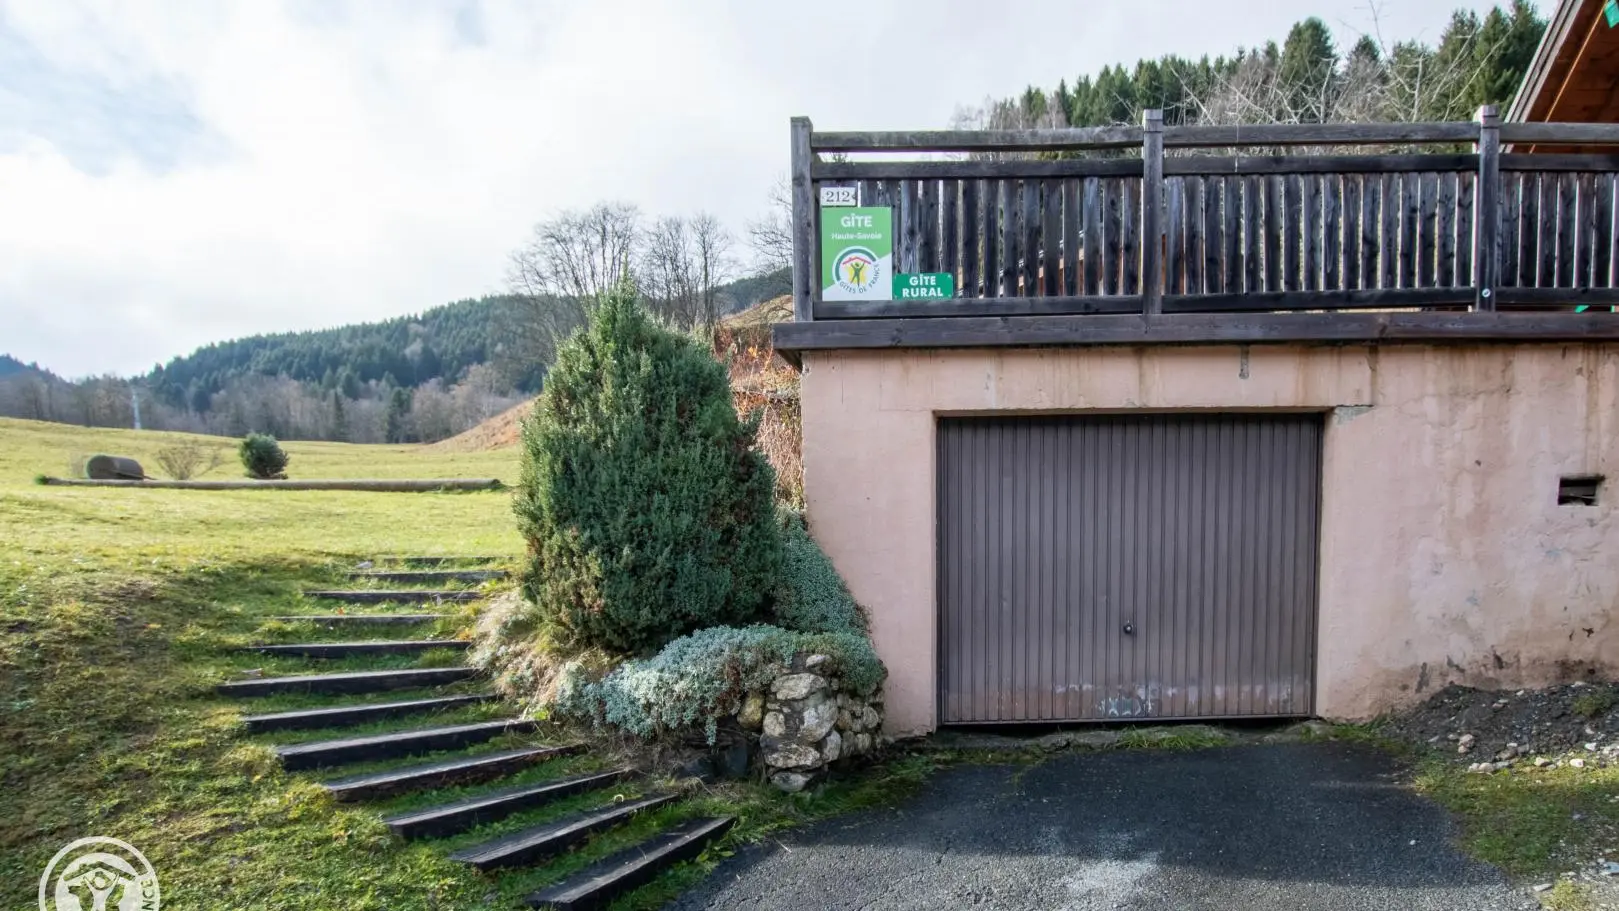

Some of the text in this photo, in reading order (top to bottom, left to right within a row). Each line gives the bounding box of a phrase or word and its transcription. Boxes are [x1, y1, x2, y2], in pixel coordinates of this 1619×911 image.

[826, 191, 850, 202] 212
[841, 213, 873, 228] GÎTE
[831, 232, 882, 240] Haute-Savoie
[909, 274, 936, 286] GÎTE
[858, 286, 867, 294] DE
[902, 287, 943, 298] RURAL
